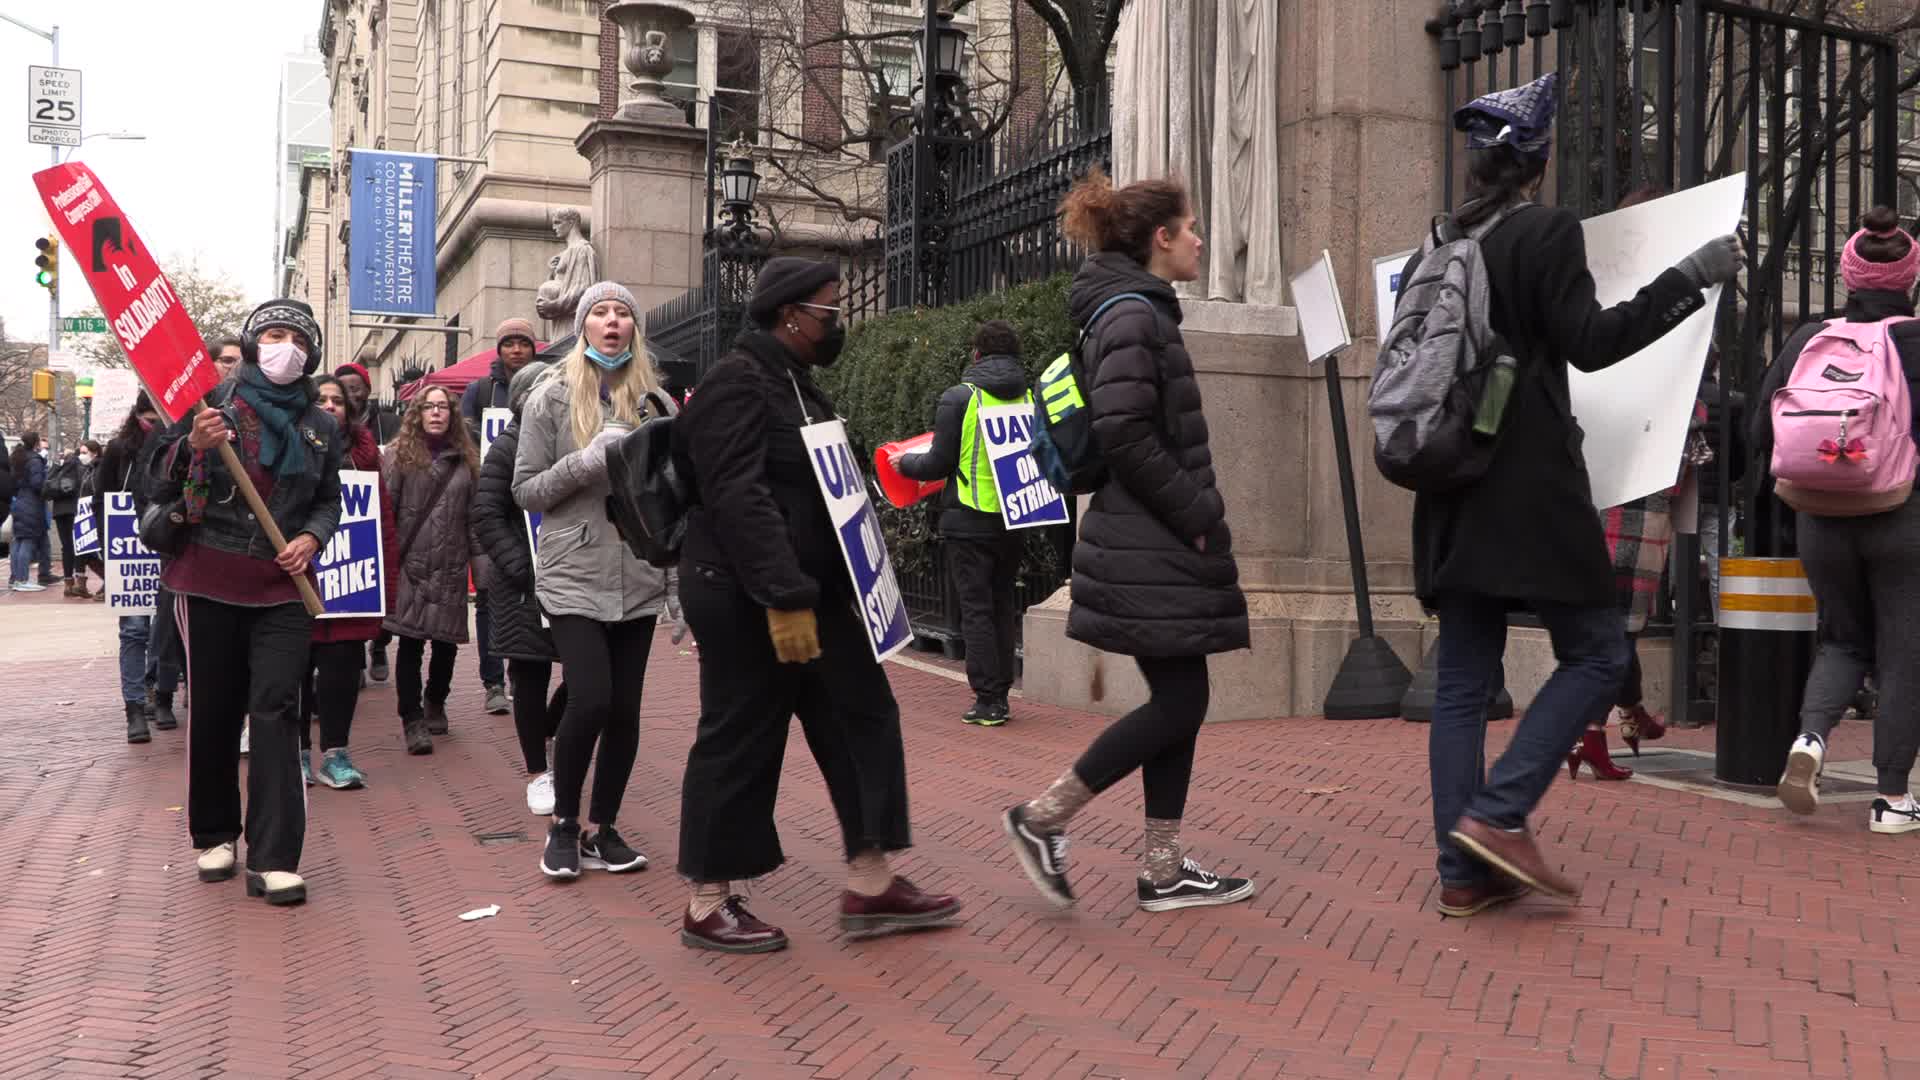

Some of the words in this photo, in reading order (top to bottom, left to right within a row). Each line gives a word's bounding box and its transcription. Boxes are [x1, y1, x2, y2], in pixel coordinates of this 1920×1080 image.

[39, 79, 71, 89] SPEED
[43, 70, 65, 79] CITY
[42, 88, 67, 97] LIMIT
[36, 98, 76, 122] 25
[32, 134, 78, 145] ENFORCED
[41, 128, 70, 137] PHOTO
[374, 161, 383, 210] SCHOOL
[384, 161, 396, 229] COLUMBIA
[374, 218, 383, 233] OF
[374, 241, 383, 264] THE
[384, 229, 395, 305] UNIVERSITY
[112, 263, 138, 292] In
[374, 271, 383, 303] ARTS
[114, 273, 176, 351] SOLIDARITY
[64, 319, 74, 331] W
[78, 319, 94, 331] 116
[1016, 453, 1040, 484] ON
[120, 562, 160, 577] UNFA
[123, 577, 160, 592] LABO
[315, 557, 377, 602] TRIKE
[110, 592, 161, 608] PRACT
